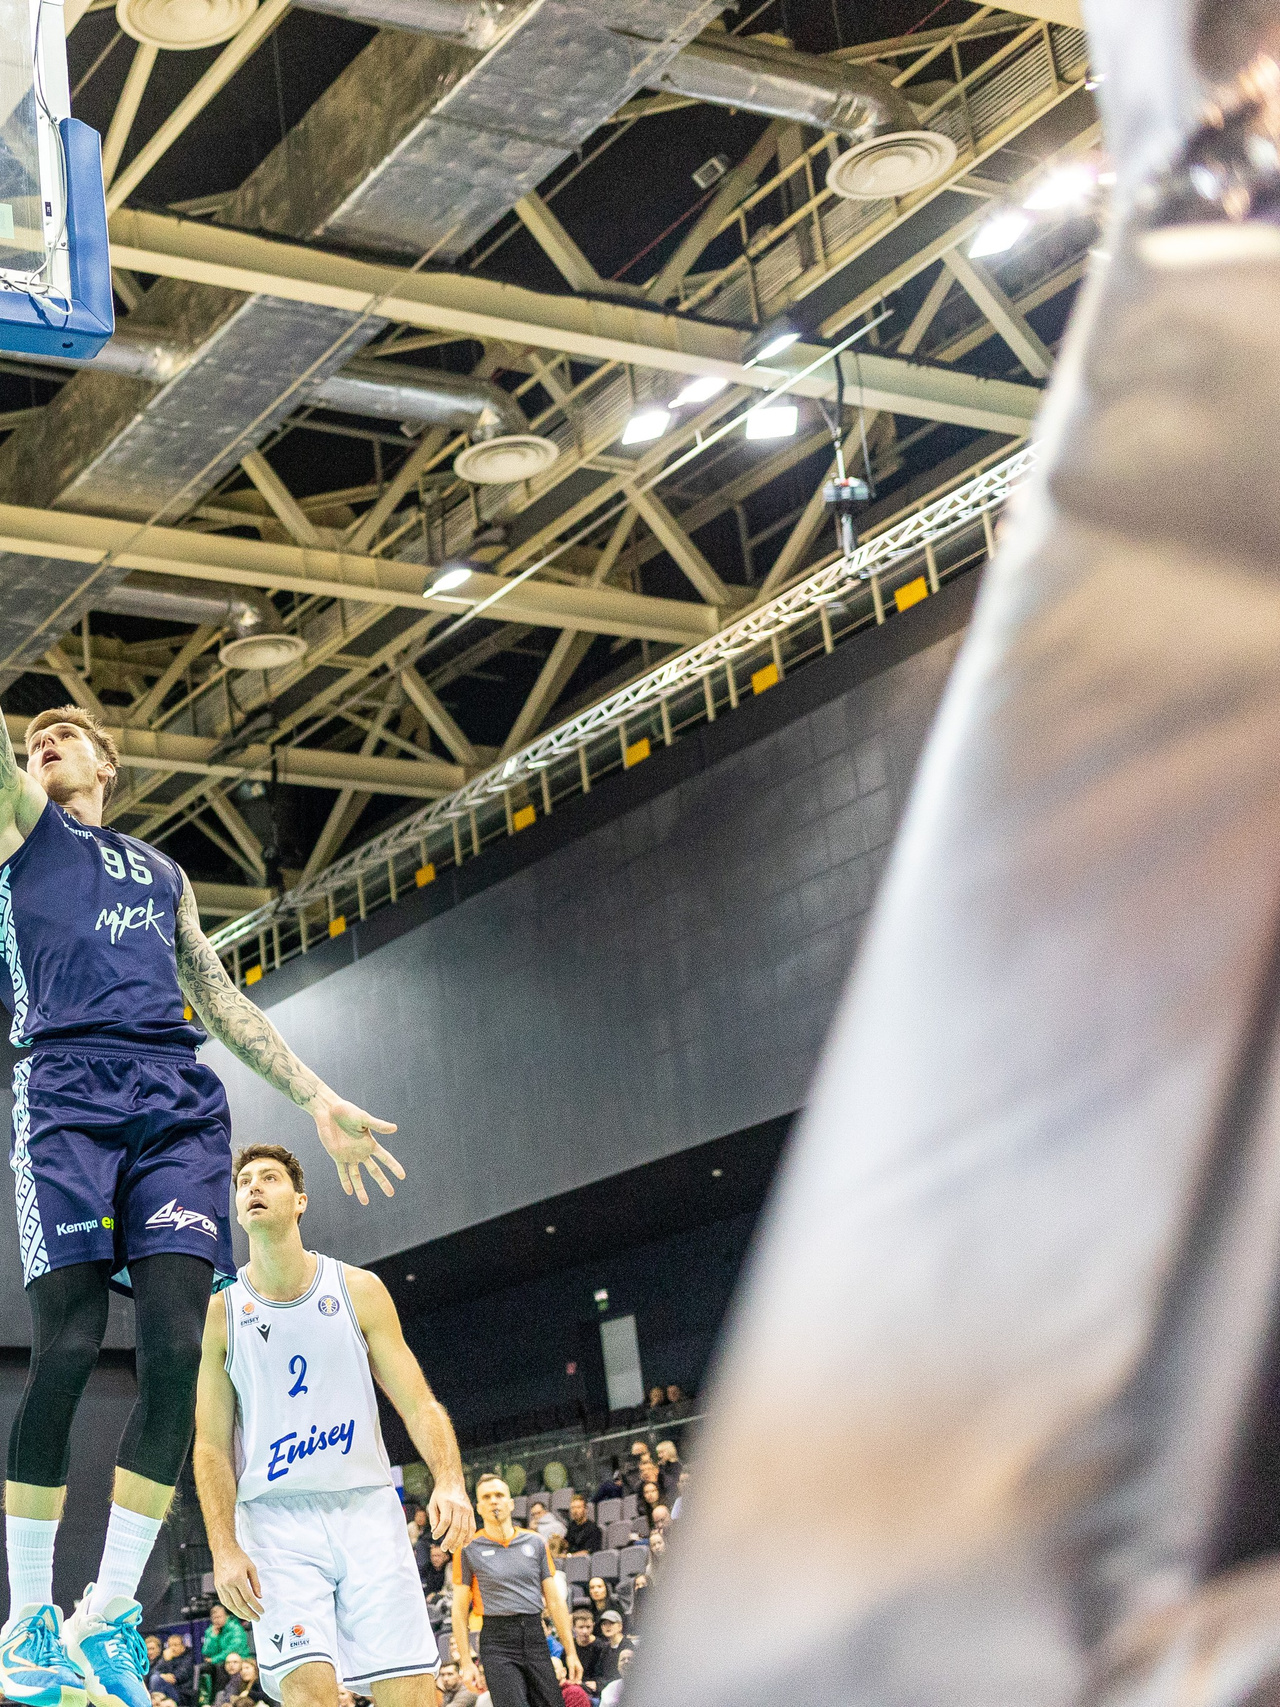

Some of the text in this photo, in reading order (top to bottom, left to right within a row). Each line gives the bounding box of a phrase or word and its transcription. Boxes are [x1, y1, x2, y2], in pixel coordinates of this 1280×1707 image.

[100, 846, 154, 886] 95
[56, 1218, 99, 1237] Kempa
[287, 1354, 309, 1398] 2
[267, 1419, 356, 1482] Enisey
[289, 1640, 310, 1648] ENISEY
